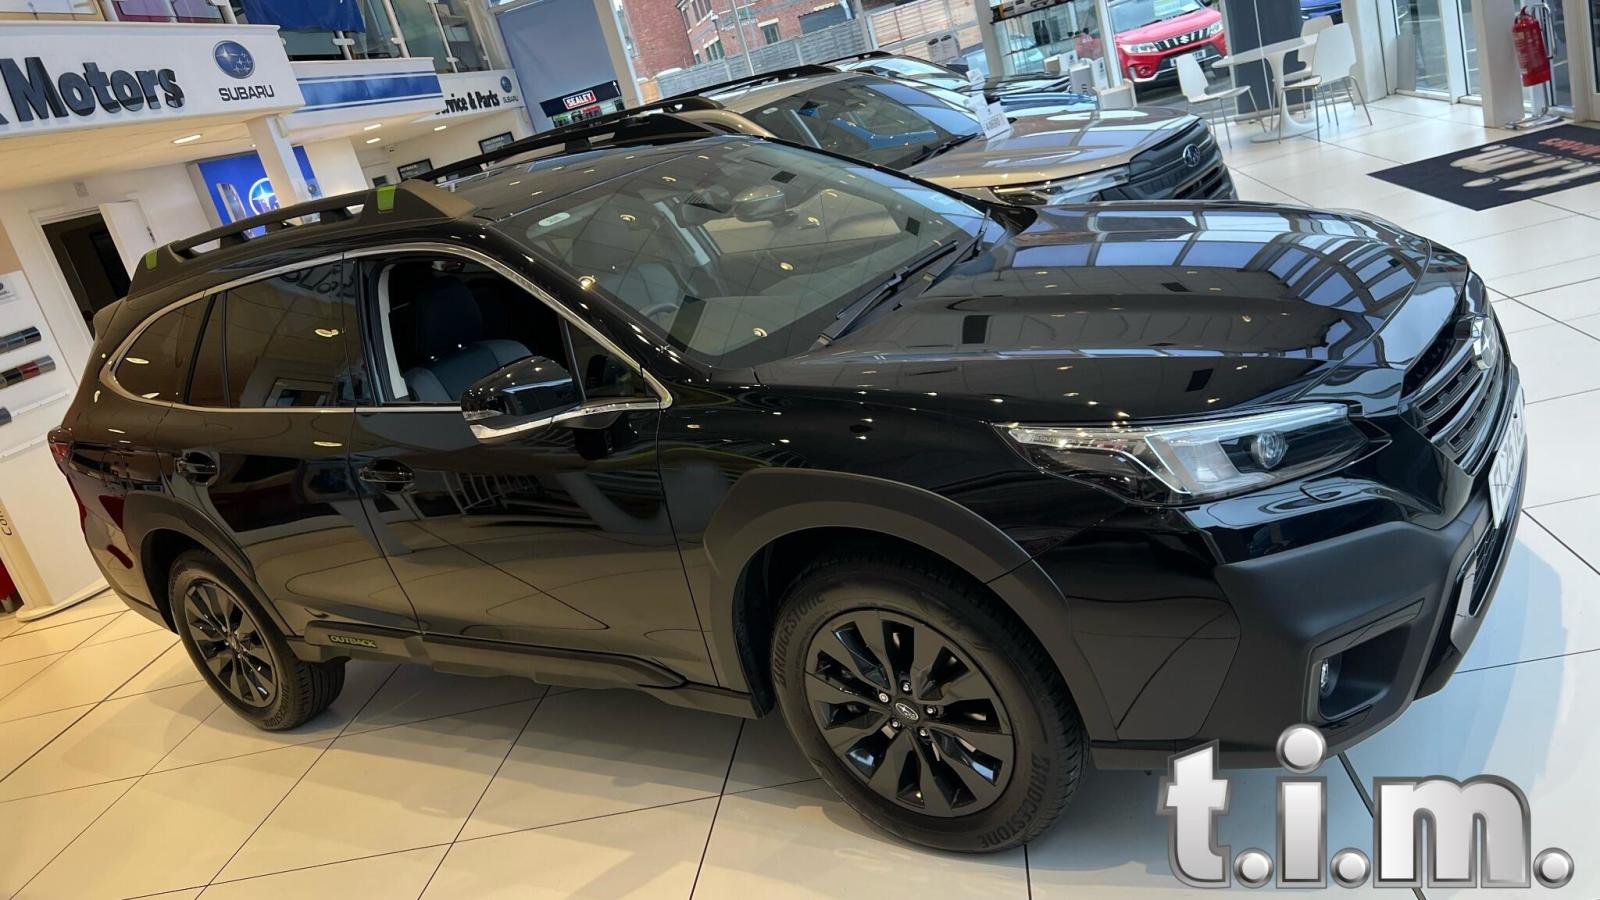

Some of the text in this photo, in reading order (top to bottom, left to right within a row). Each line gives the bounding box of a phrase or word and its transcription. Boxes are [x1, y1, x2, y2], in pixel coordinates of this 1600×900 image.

[0, 56, 186, 123] Motors
[218, 84, 275, 102] SUBARU
[435, 89, 501, 115] rvice & Parts
[566, 92, 593, 107] SEALEY
[328, 634, 378, 649] OUTBACK
[773, 591, 825, 689] BRIDGESTONE
[977, 751, 1051, 849] BRIDGESTONE
